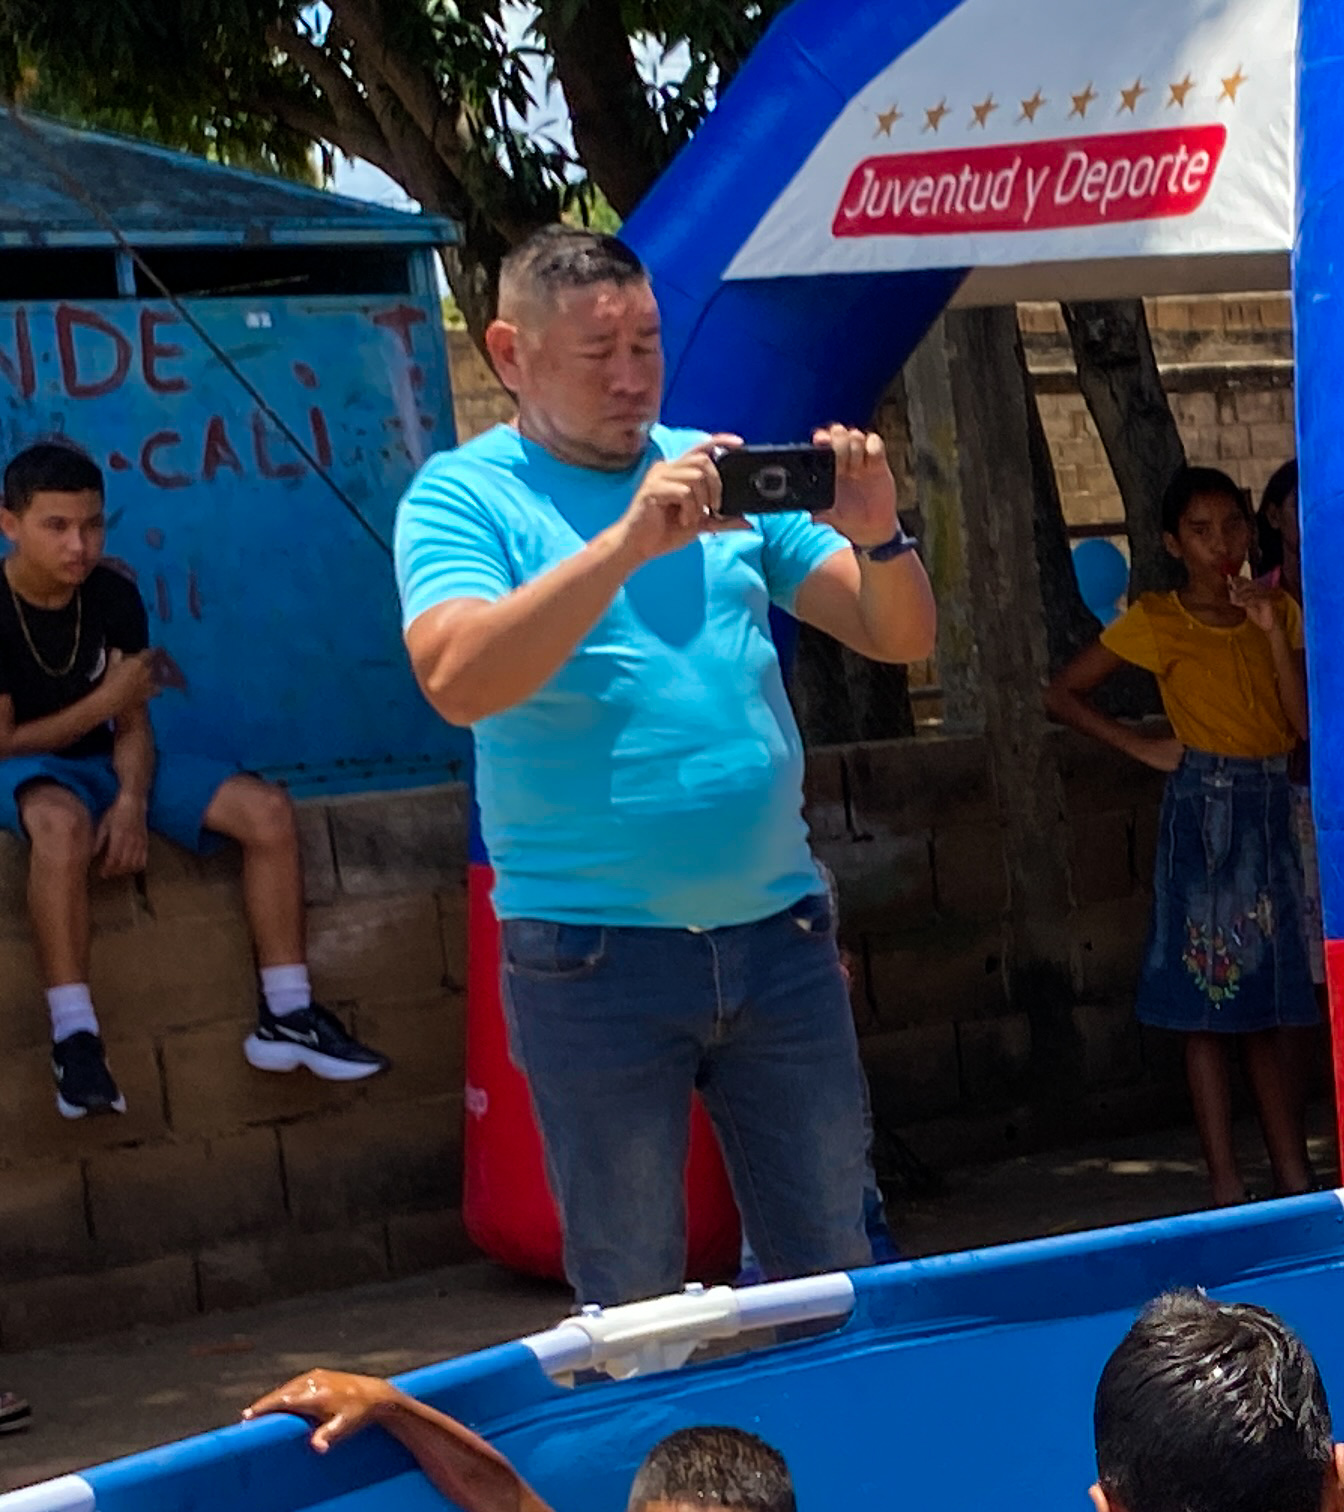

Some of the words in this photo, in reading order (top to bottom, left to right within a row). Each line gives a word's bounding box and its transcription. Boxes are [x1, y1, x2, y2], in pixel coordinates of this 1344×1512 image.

[844, 155, 1022, 219] Juventud
[1023, 164, 1050, 224] y
[1054, 144, 1210, 216] Deporte
